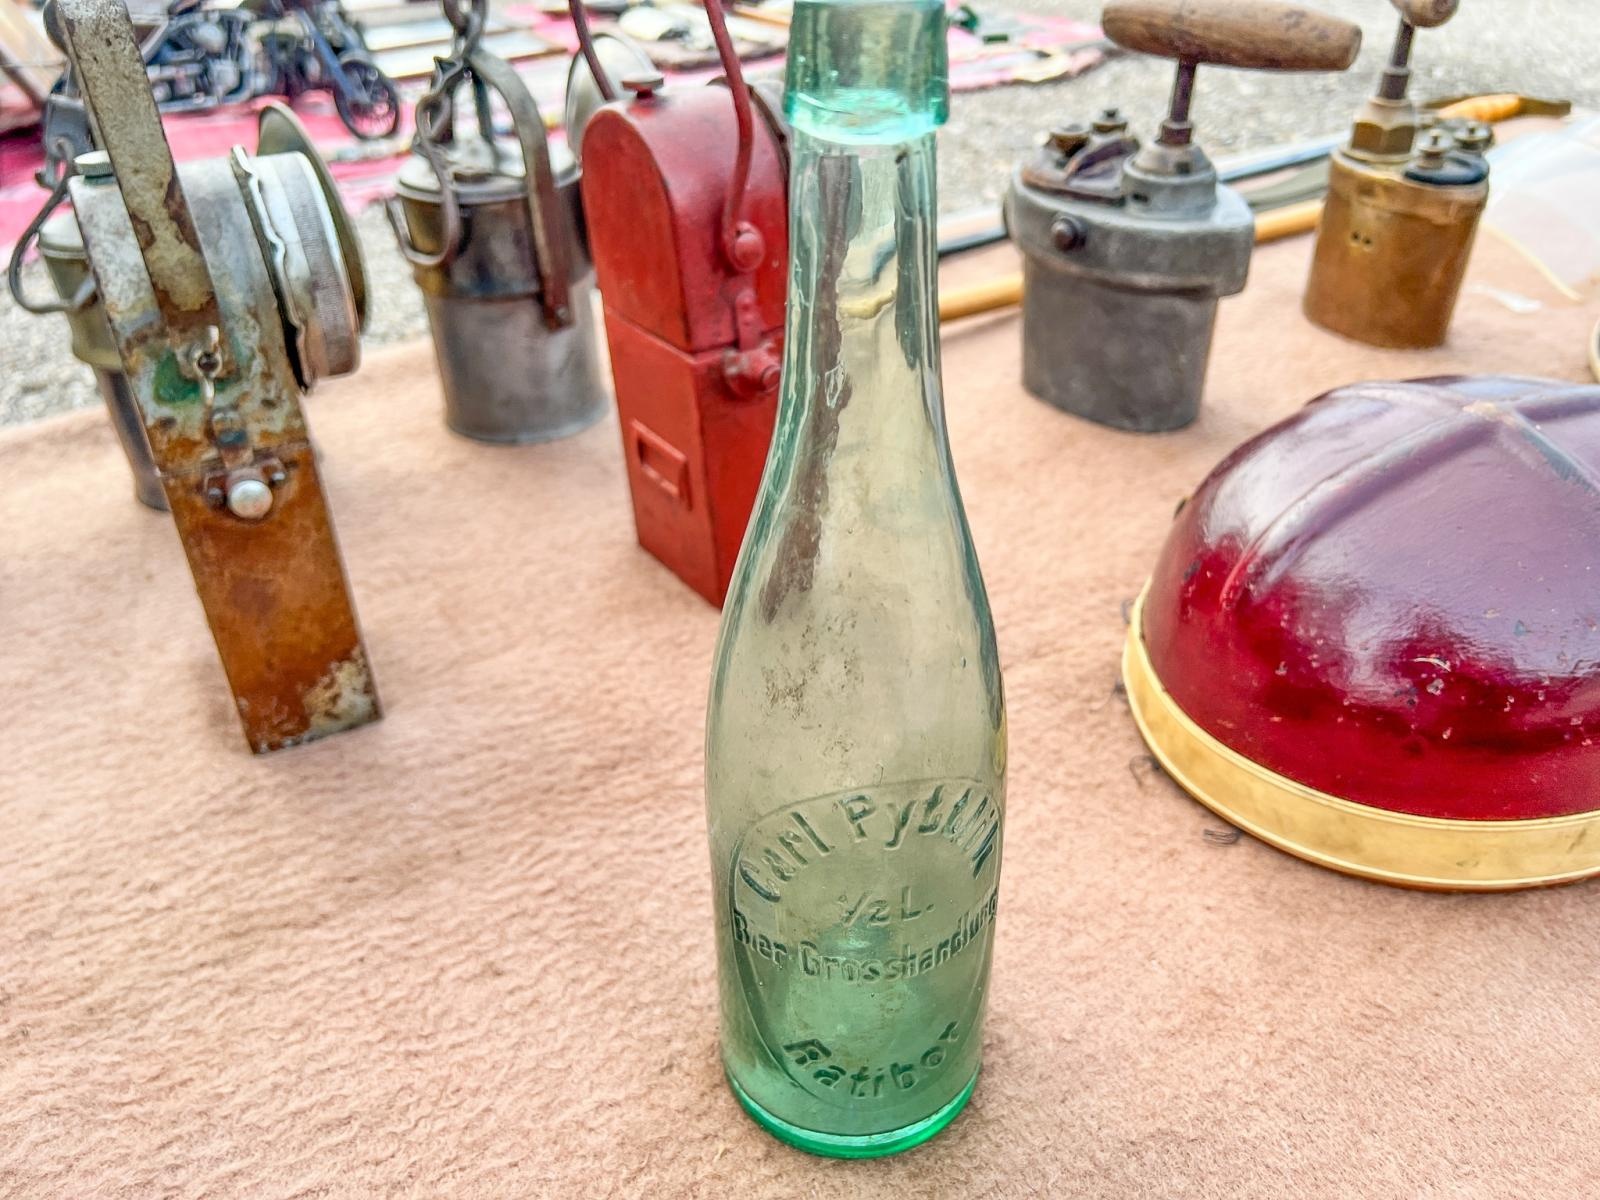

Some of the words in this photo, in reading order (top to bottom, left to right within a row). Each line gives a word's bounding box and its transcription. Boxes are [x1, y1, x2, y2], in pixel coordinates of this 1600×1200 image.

[739, 810, 831, 902] Carl
[733, 906, 788, 966] Bier
[799, 886, 998, 983] Grosshandlung
[782, 1019, 959, 1099] Ratibor
